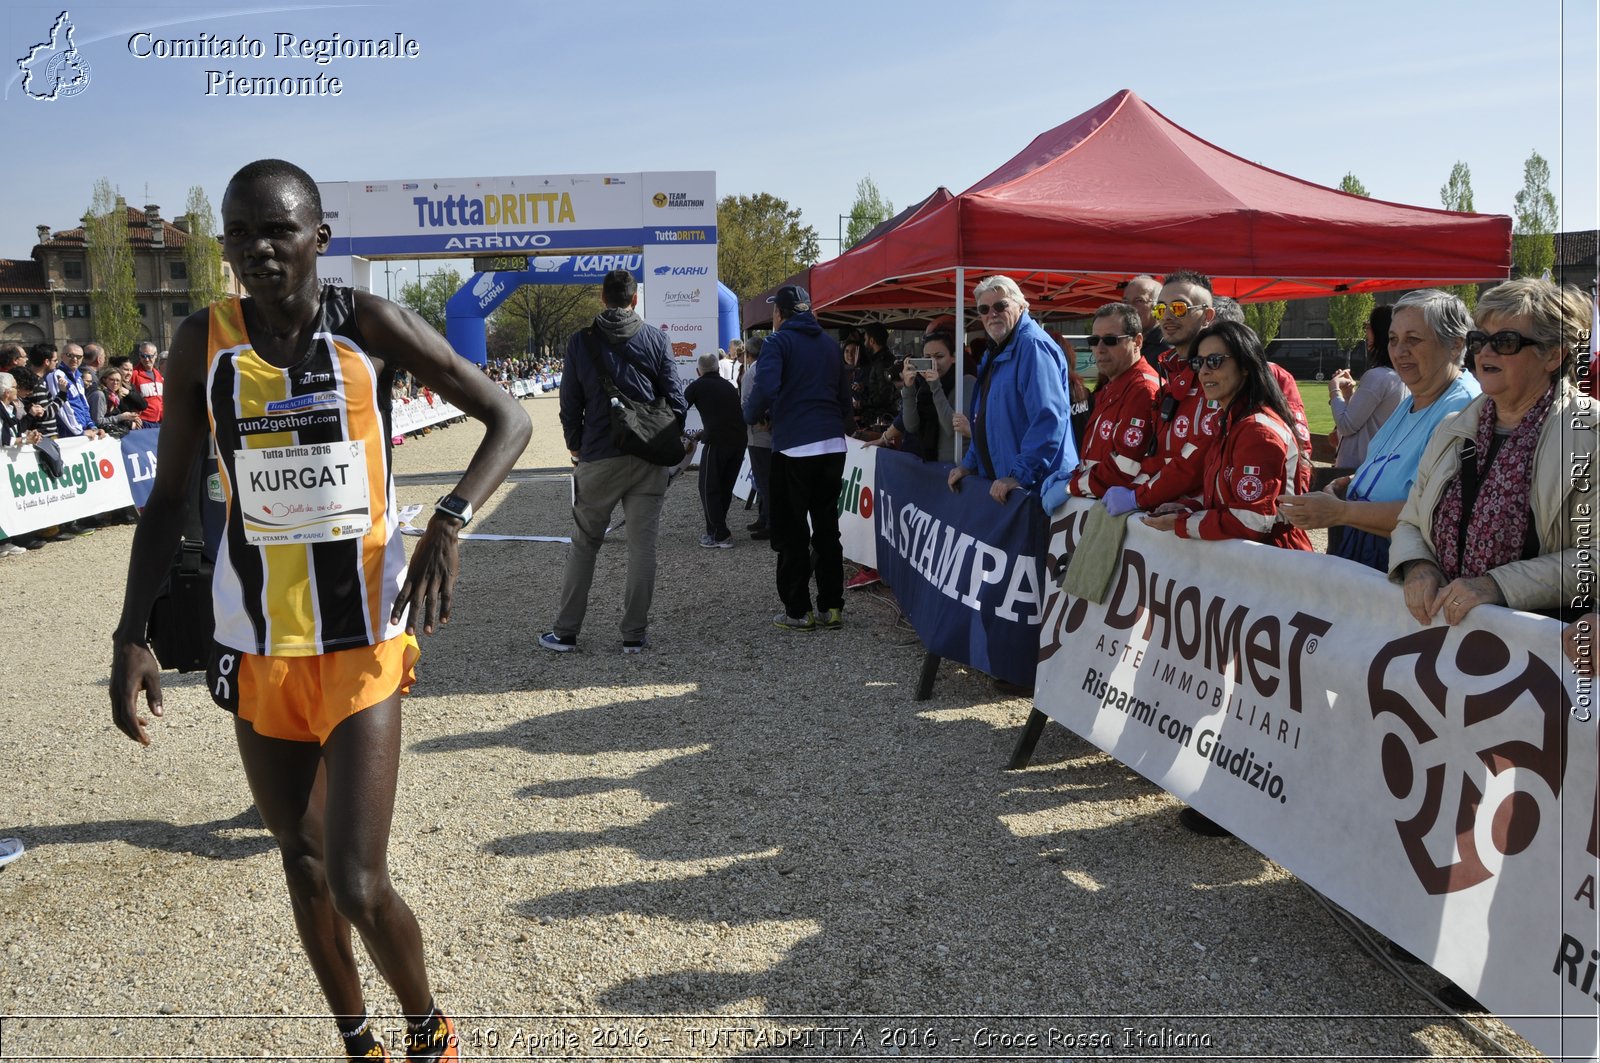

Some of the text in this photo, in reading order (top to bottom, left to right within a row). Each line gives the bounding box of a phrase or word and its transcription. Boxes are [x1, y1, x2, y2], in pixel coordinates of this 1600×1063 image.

[413, 192, 576, 228] TuttaDRITTA
[668, 199, 705, 207] MARATHON
[323, 211, 339, 219] THON
[444, 234, 552, 250] ARRIVO
[573, 255, 643, 272] KARHU
[671, 266, 709, 276] KARHU
[317, 277, 344, 285] AMPA
[478, 281, 505, 310] KARHU
[670, 323, 703, 331] foodora
[237, 415, 338, 432] run2gether.com
[261, 445, 332, 460] Tutta Dritta 2016
[249, 463, 349, 493] KURGAT
[879, 489, 1042, 625] LA STAMPA
[1095, 634, 1301, 749] ASTE IMMOBILIARI
[1081, 667, 1287, 804] Risparmi con Giudizio.
